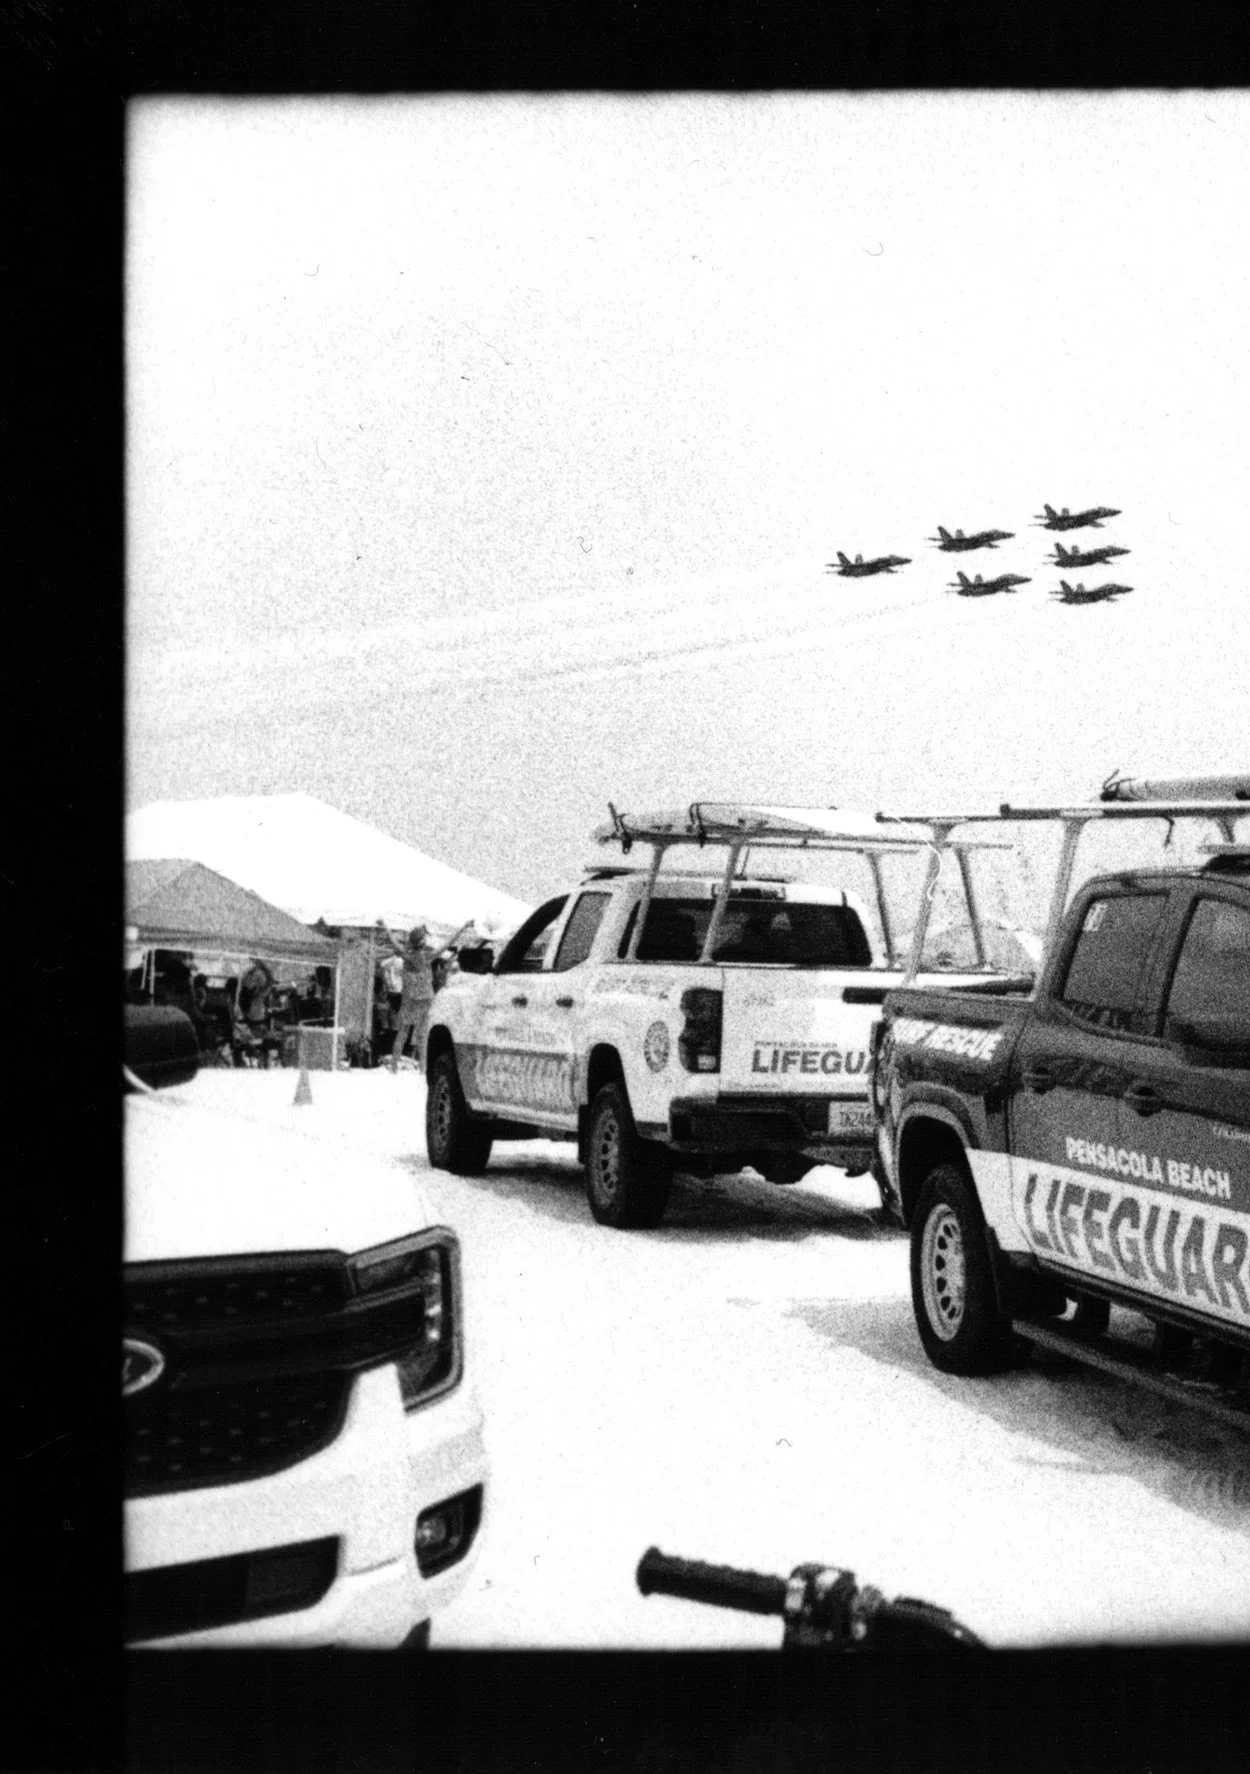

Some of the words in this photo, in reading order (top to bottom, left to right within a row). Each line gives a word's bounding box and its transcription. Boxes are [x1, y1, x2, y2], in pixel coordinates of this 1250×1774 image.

[922, 1024, 1003, 1061] RESCUE
[1066, 1137, 1164, 1185] PENSACOLA
[1167, 1159, 1231, 1200] BEACH
